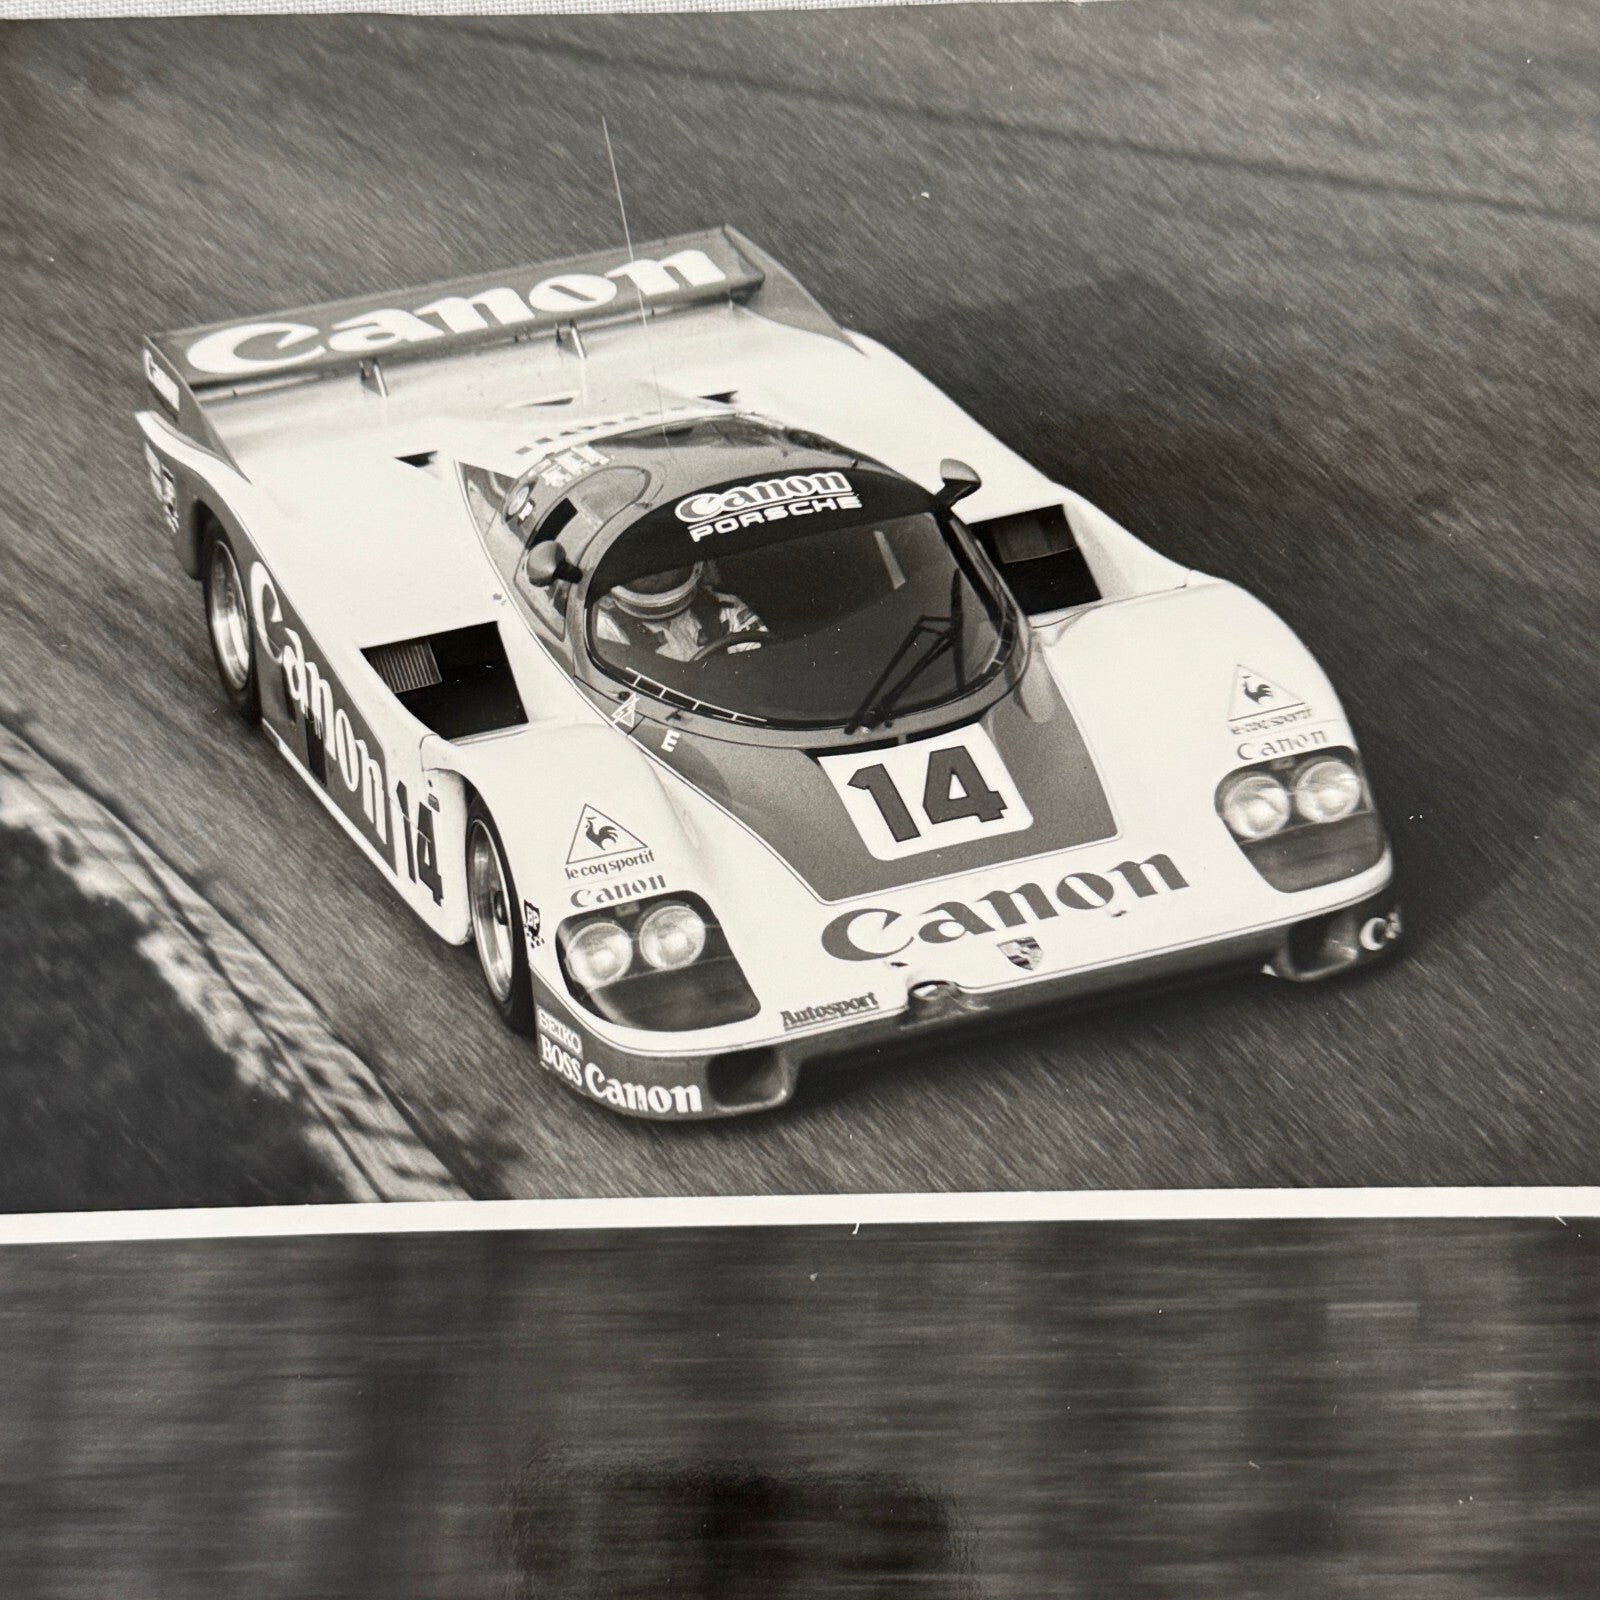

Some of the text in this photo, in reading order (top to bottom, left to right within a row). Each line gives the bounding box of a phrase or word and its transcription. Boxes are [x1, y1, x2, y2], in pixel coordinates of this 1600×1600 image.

[186, 250, 727, 374] Canon
[675, 472, 853, 523] Canon
[688, 496, 863, 543] PORSCHE
[250, 561, 388, 845] Canon
[660, 729, 681, 753] E
[1237, 730, 1328, 761] Canon
[847, 745, 1008, 842] 14
[396, 779, 444, 907] 14
[564, 849, 656, 880] le coq sportif
[570, 874, 667, 908] Canon
[821, 853, 1191, 961] Canon
[538, 1008, 582, 1055] SEIKO
[780, 992, 878, 1027] Autosport
[540, 1033, 583, 1087] BOSS
[584, 1062, 703, 1114] Canon
